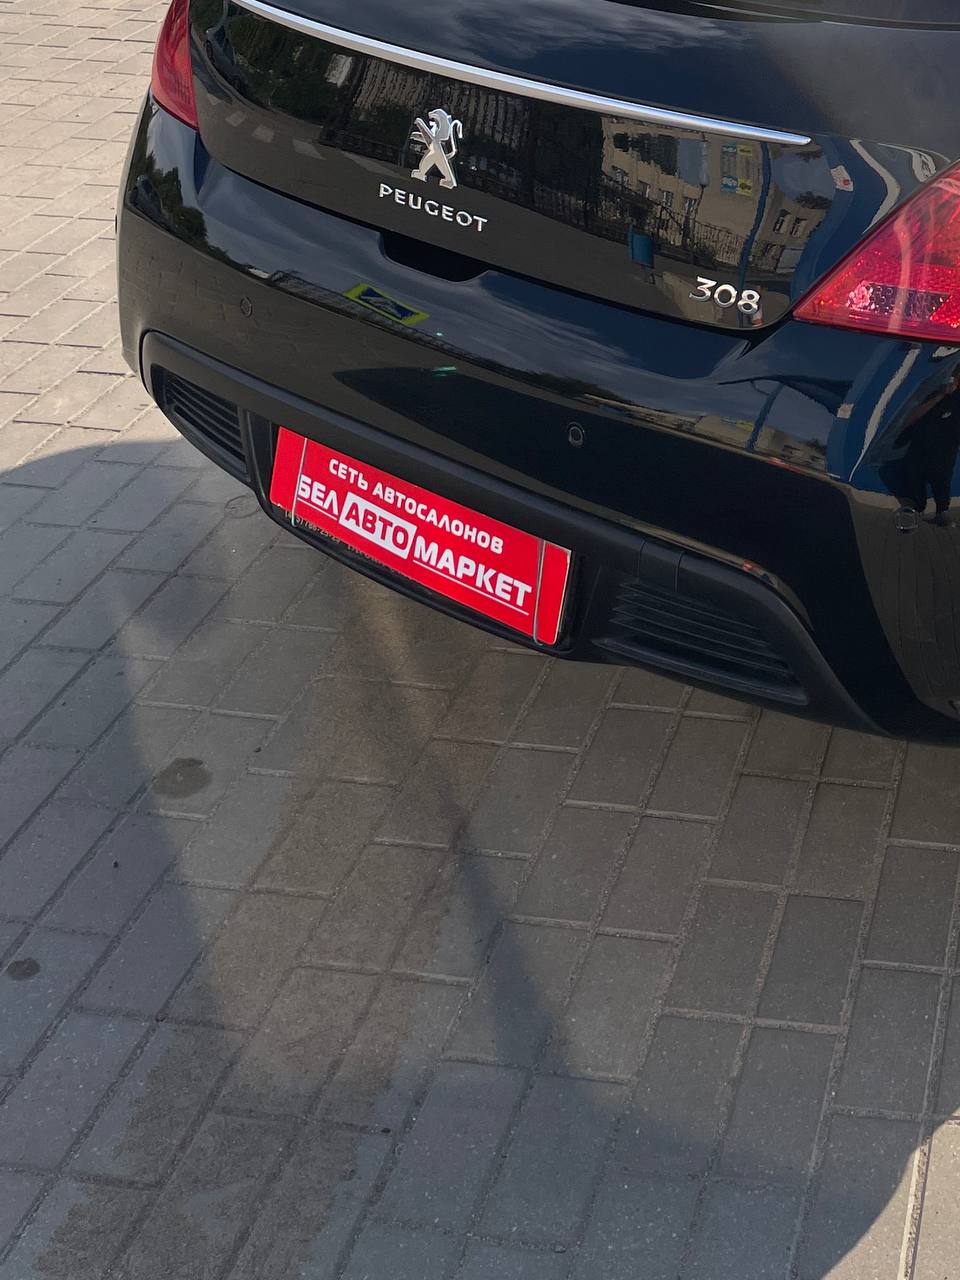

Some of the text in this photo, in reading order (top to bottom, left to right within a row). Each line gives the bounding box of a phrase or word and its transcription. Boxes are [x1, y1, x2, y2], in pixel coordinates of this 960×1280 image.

[378, 183, 488, 233] PEUGEOT
[688, 276, 762, 316] 308
[329, 458, 368, 491] СЕТЬ
[372, 482, 504, 555] АВТОСАЛОНОВ
